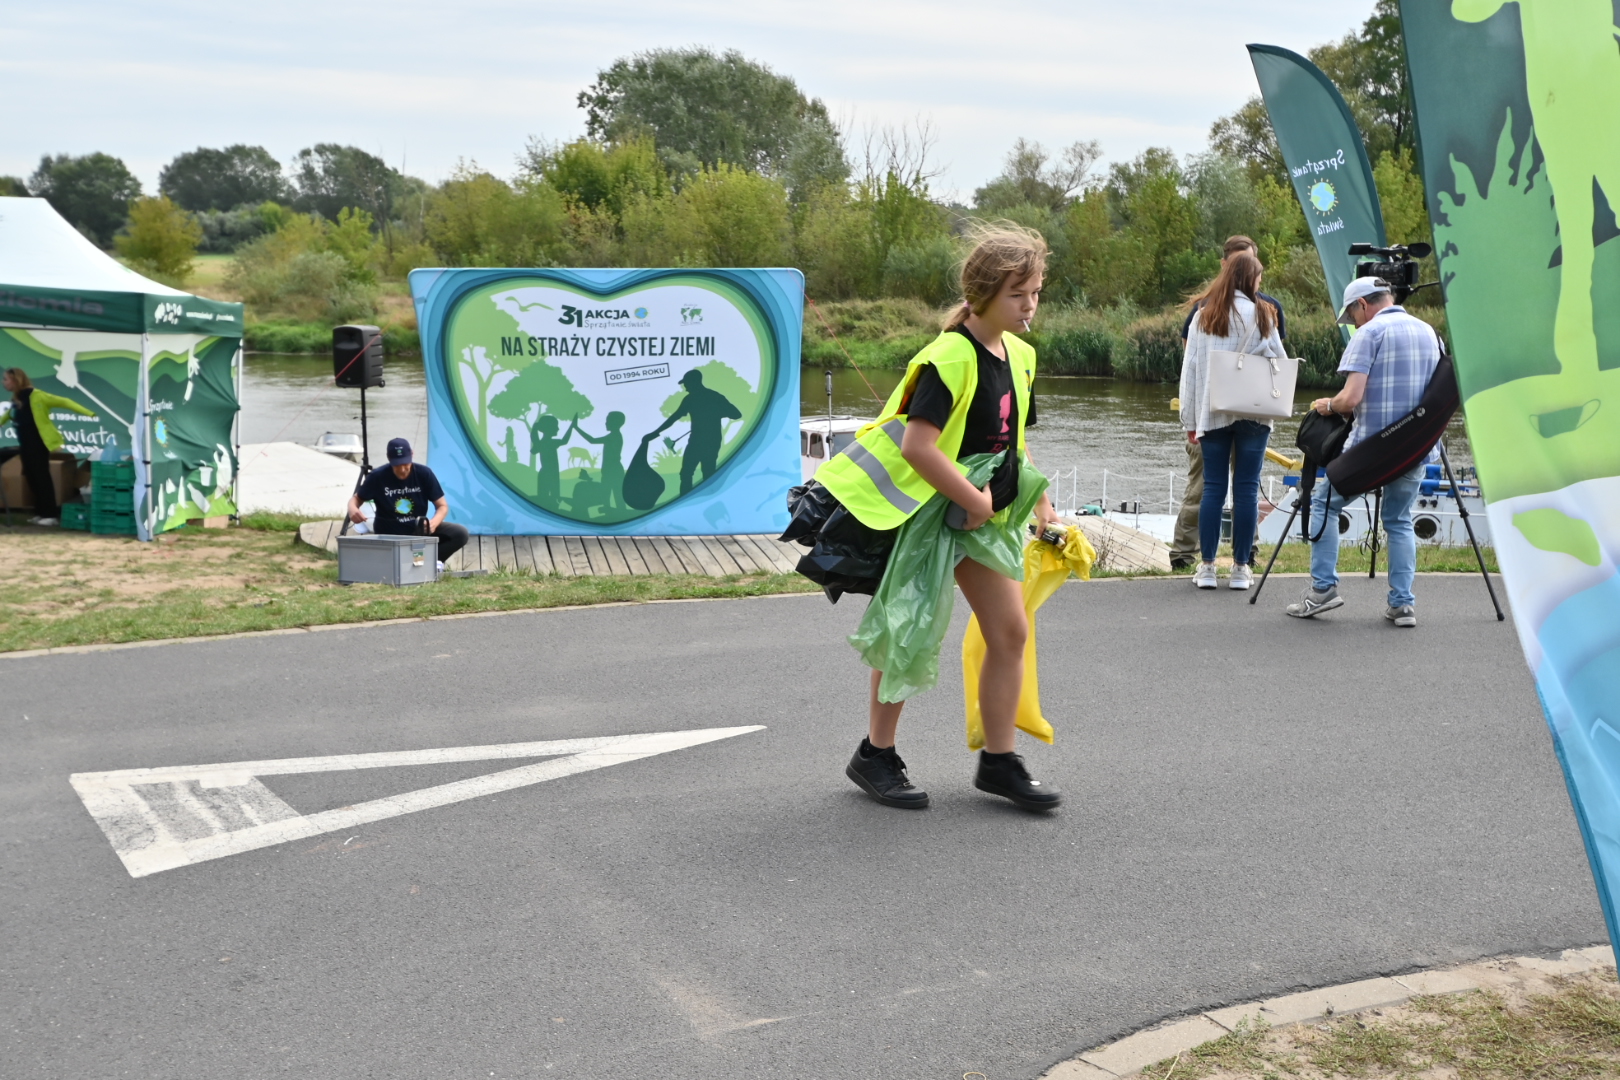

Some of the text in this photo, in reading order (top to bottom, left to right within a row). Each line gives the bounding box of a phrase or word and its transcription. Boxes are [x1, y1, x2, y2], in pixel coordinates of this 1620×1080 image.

[558, 304, 583, 328] 31
[585, 309, 631, 320] AKCJA
[501, 333, 715, 356] NA STRAŻY CZYSTEJ ZIEMI
[609, 367, 666, 381] OD 1994 ROKU
[56, 413, 77, 422] 1994
